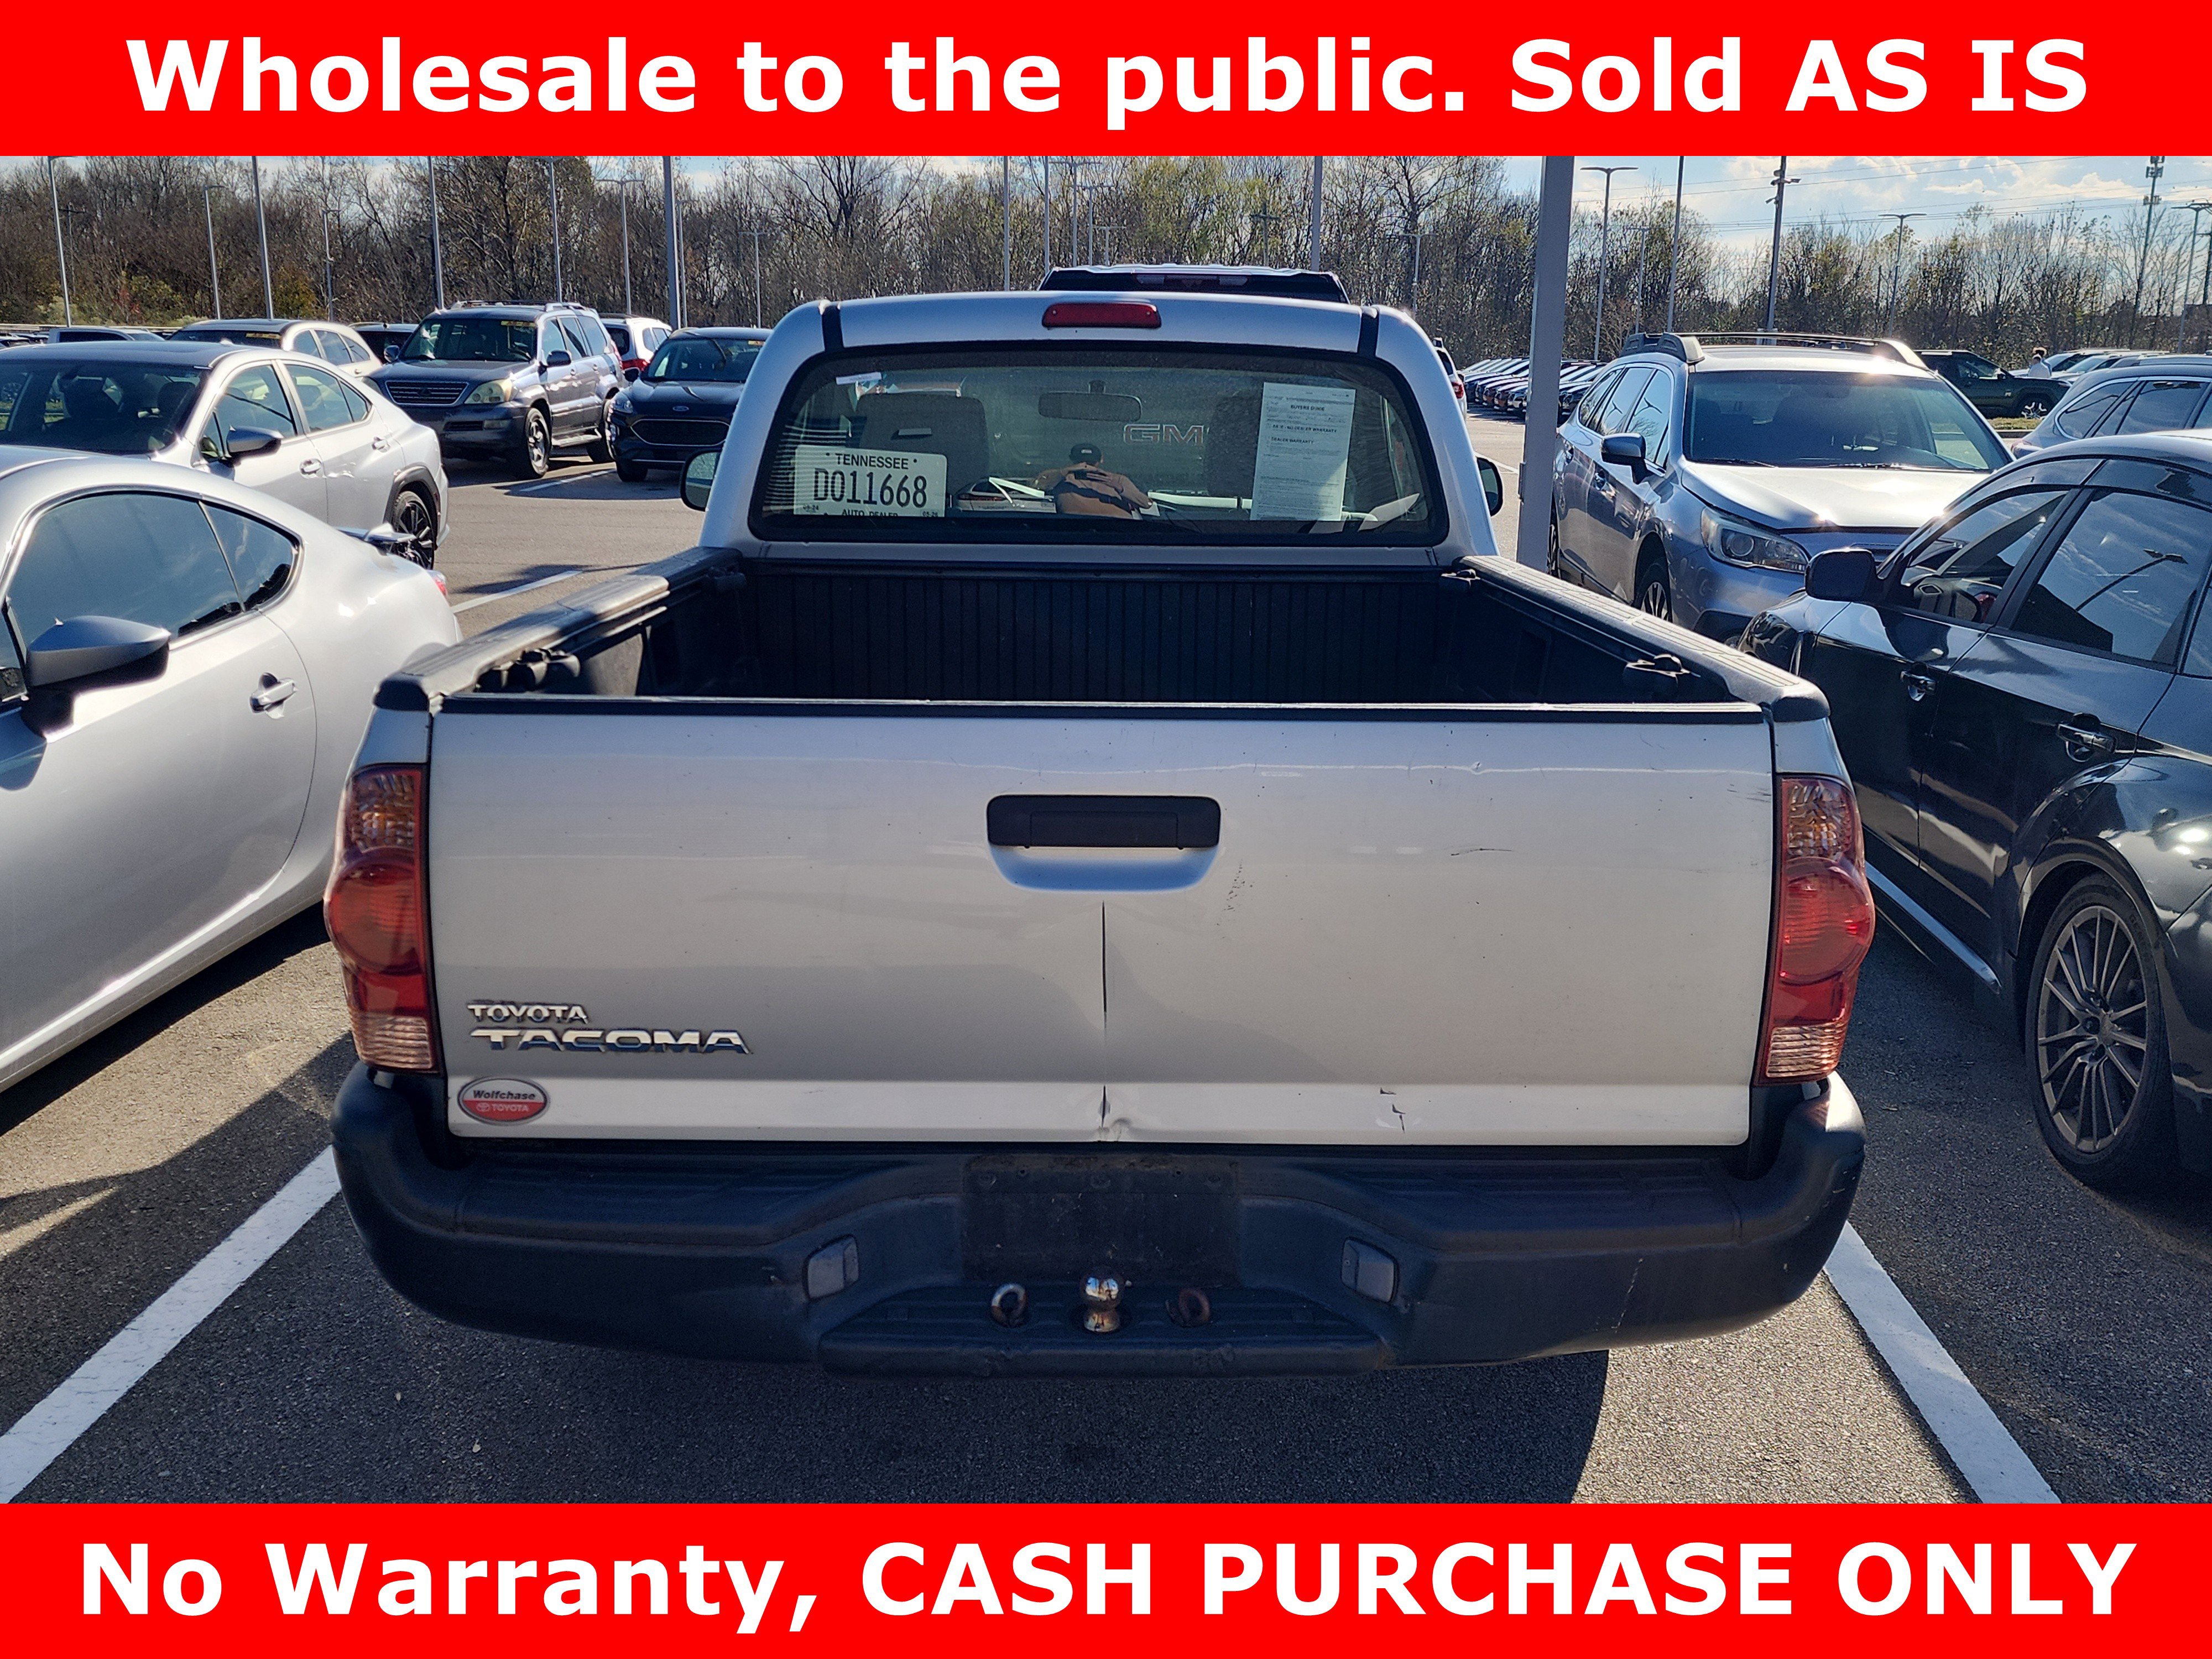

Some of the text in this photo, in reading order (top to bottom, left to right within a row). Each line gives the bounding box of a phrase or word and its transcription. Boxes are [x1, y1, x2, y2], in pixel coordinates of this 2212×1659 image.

[1123, 424, 1210, 446] GM
[835, 453, 909, 469] TENNESSEE
[813, 468, 927, 508] D011668
[467, 1003, 590, 1024] TOYOTA
[470, 1029, 752, 1055] TACOMA
[473, 1090, 536, 1100] Wolfchase
[492, 1104, 529, 1112] TOYOTA
